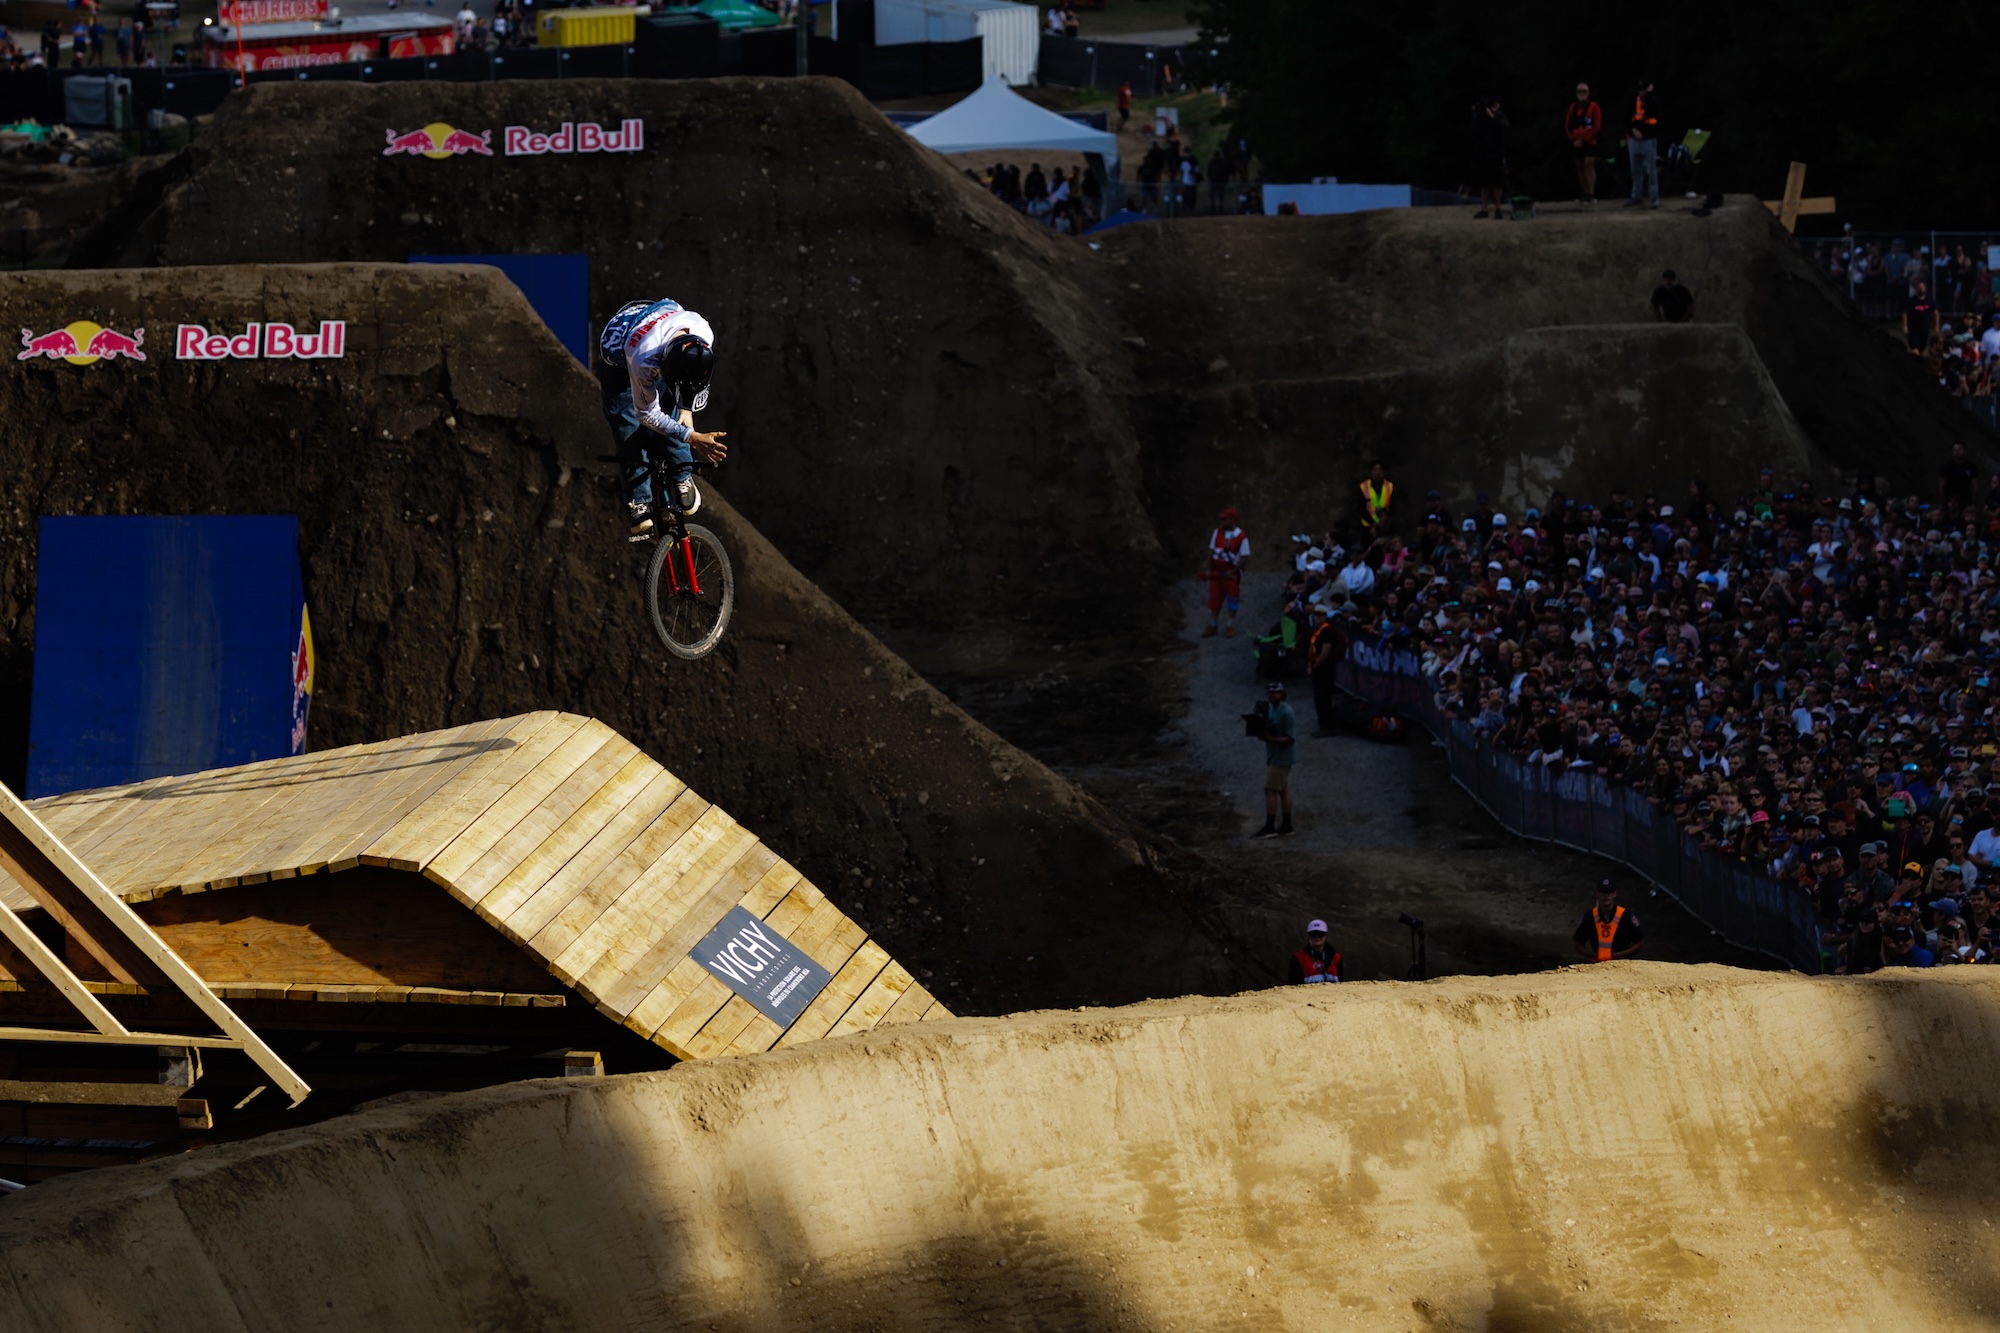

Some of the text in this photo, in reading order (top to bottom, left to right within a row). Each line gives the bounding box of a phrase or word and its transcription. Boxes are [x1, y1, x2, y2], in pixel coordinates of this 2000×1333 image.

[229, 0, 320, 23] CHURROS
[505, 119, 643, 155] Red Bull
[177, 321, 345, 359] Red Bull
[709, 920, 781, 985] VICHY
[753, 953, 791, 993] LABORATOIRES
